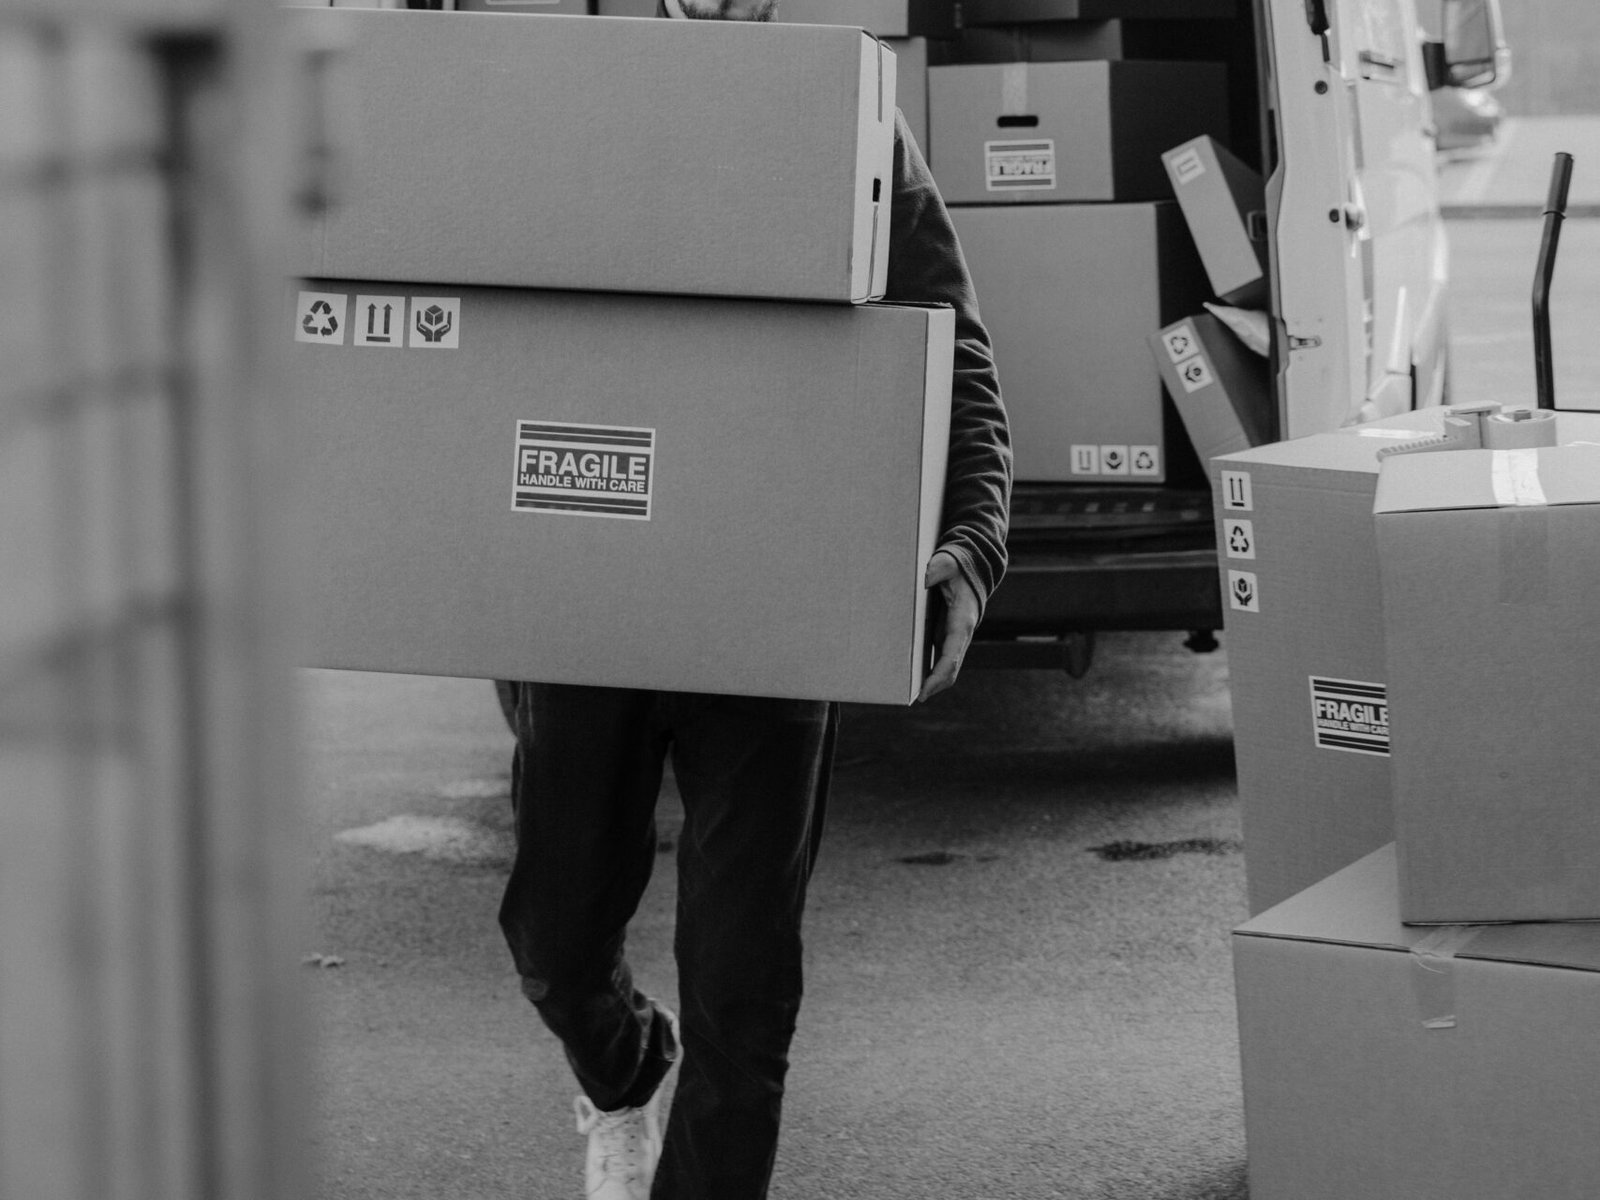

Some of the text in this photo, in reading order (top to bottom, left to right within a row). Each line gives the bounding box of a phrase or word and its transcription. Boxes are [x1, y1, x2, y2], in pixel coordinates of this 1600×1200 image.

[520, 449, 647, 481] FRAGILE
[520, 473, 645, 493] HANDLE WITH CARE
[1316, 699, 1389, 726] FRAGILE
